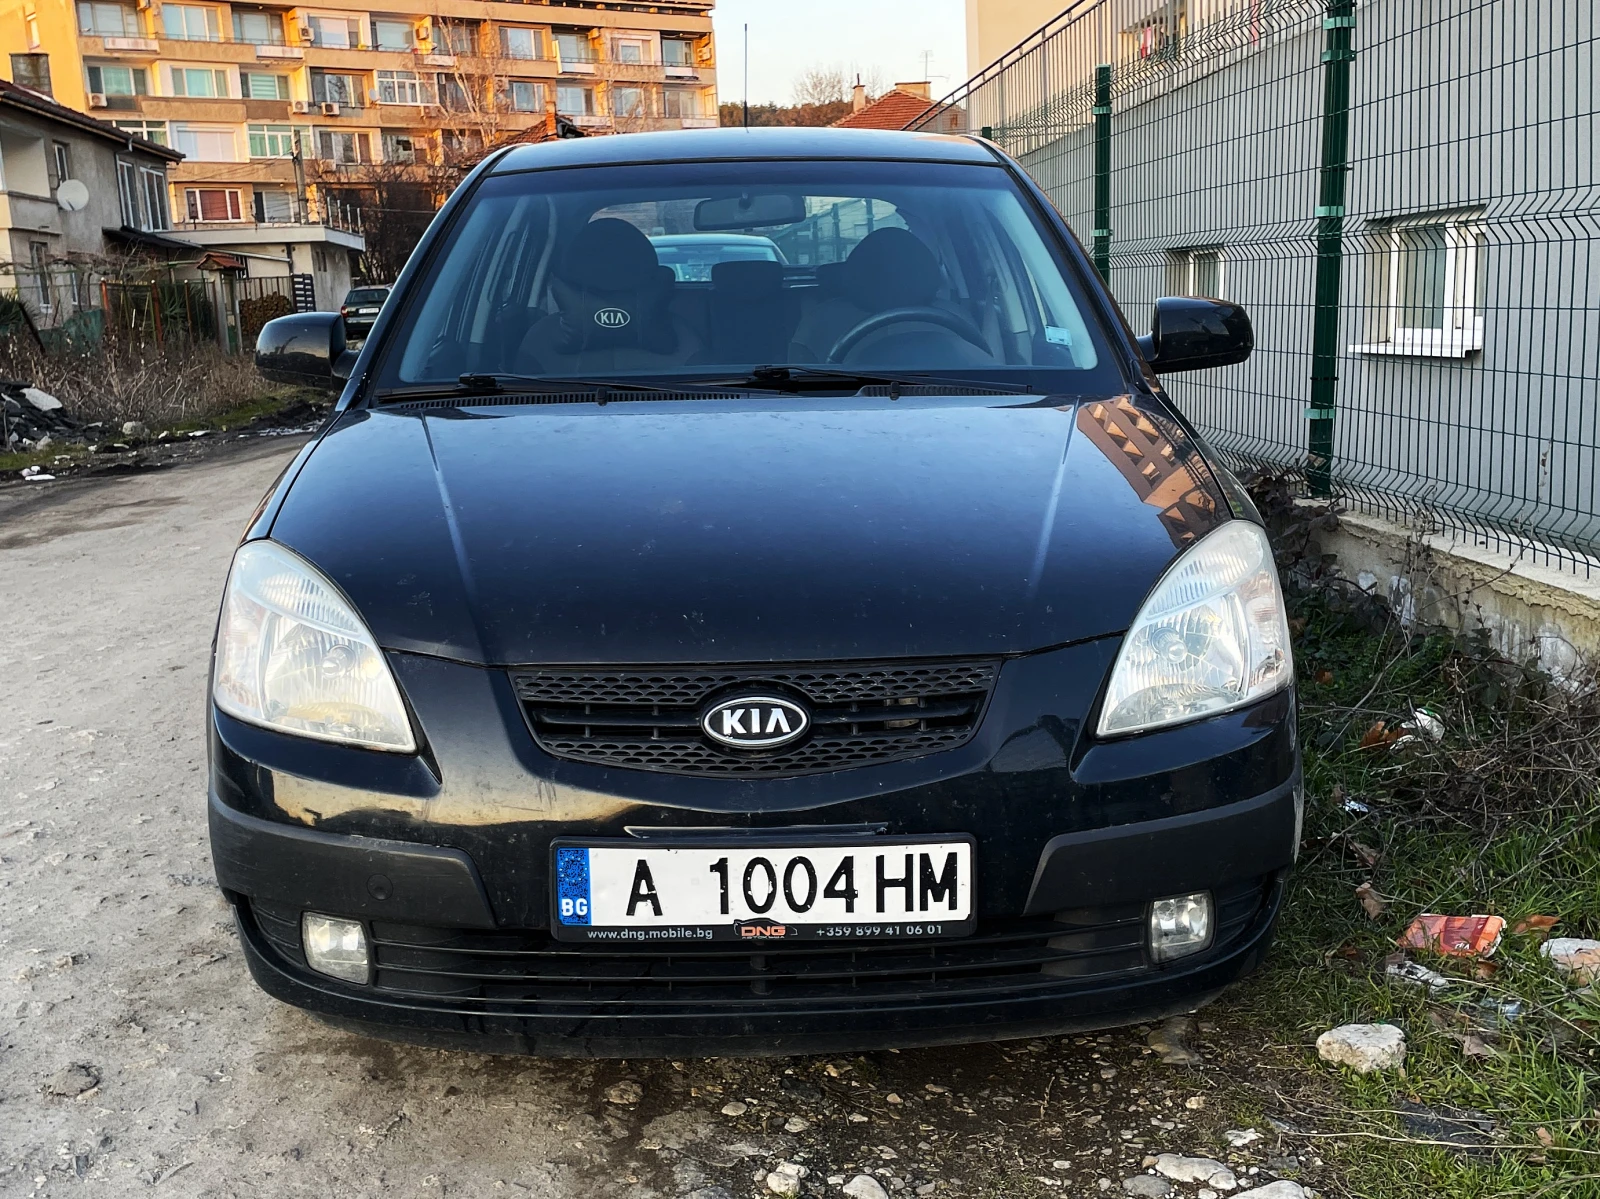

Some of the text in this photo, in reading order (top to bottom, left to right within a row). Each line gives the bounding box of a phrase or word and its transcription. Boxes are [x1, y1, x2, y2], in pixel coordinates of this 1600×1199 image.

[600, 312, 625, 324] KIA
[722, 708, 791, 735] KIA
[626, 851, 958, 916] A 1004 HM
[561, 898, 588, 916] BG
[587, 928, 713, 941] www.dng.mobile.bg
[741, 925, 786, 936] DNG
[816, 924, 942, 937] +359 899 41 06 01
